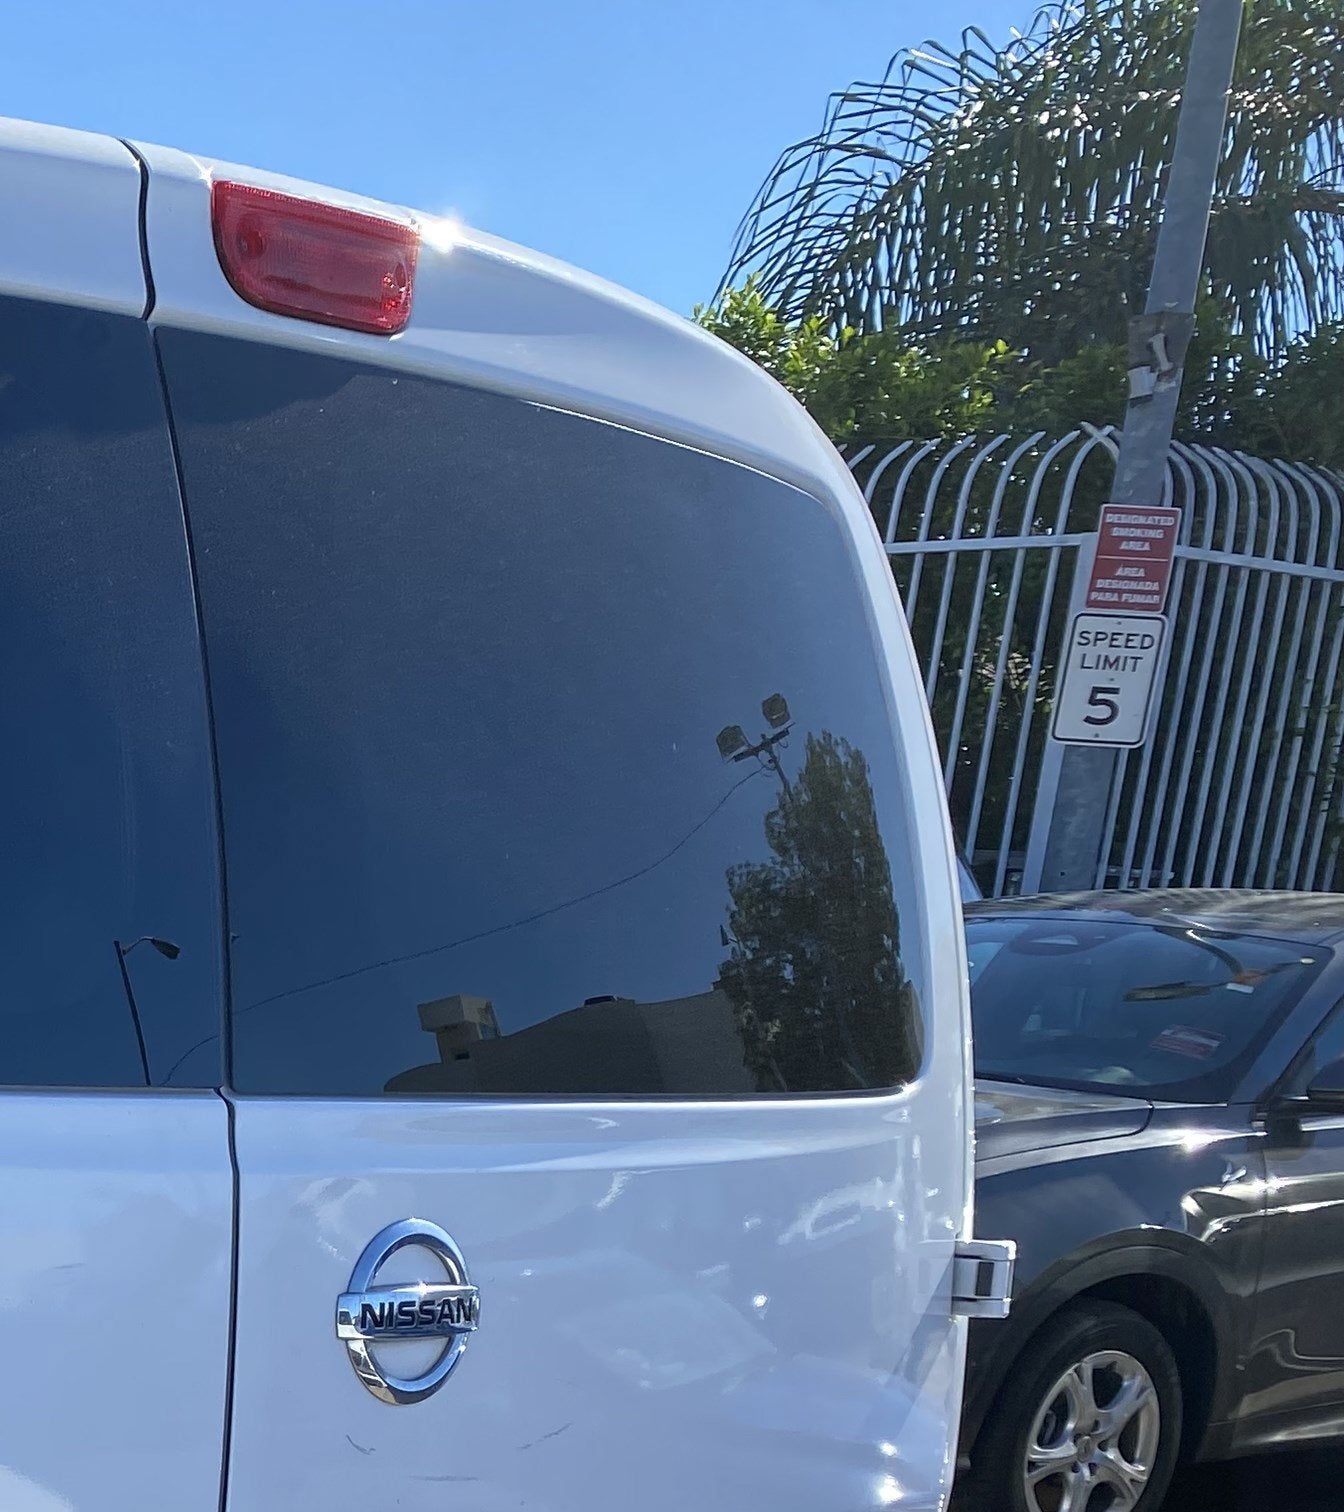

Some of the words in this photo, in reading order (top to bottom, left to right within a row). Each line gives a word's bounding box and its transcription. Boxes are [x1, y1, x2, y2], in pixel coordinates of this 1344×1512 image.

[1106, 514, 1174, 526] DESIGNATED
[1111, 527, 1164, 539] SMOKING
[1120, 541, 1150, 551] AREA
[1096, 579, 1160, 591] DESIGNADA
[1090, 592, 1119, 601] PARA
[1122, 593, 1160, 604] FUMAR
[1077, 630, 1155, 650] SPEED
[1080, 653, 1143, 673] LIMIT
[1083, 686, 1120, 726] 5
[361, 1297, 473, 1329] NISSAN
